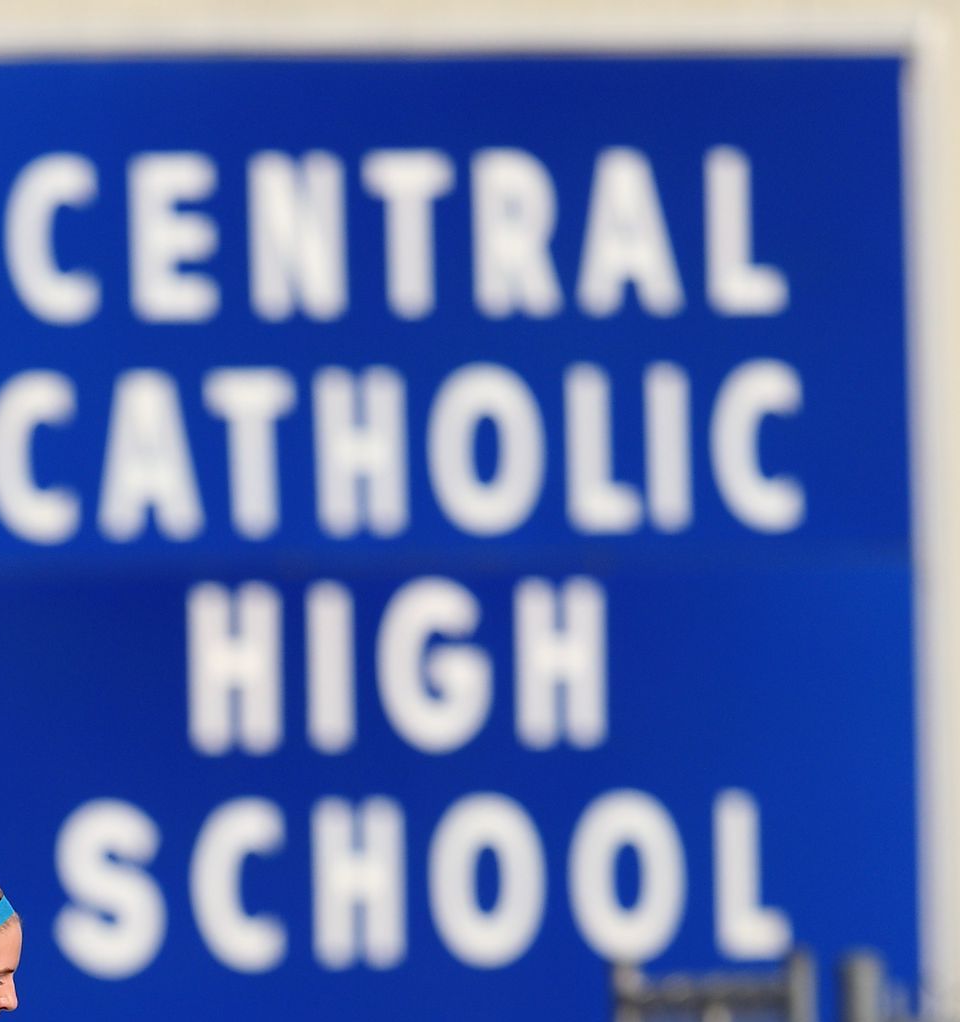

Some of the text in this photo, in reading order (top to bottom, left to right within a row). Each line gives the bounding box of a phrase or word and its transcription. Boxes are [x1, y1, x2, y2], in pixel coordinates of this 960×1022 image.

[6, 149, 786, 322] CENTRAL
[188, 580, 605, 752] HIGH
[57, 793, 790, 976] SCHOOL
